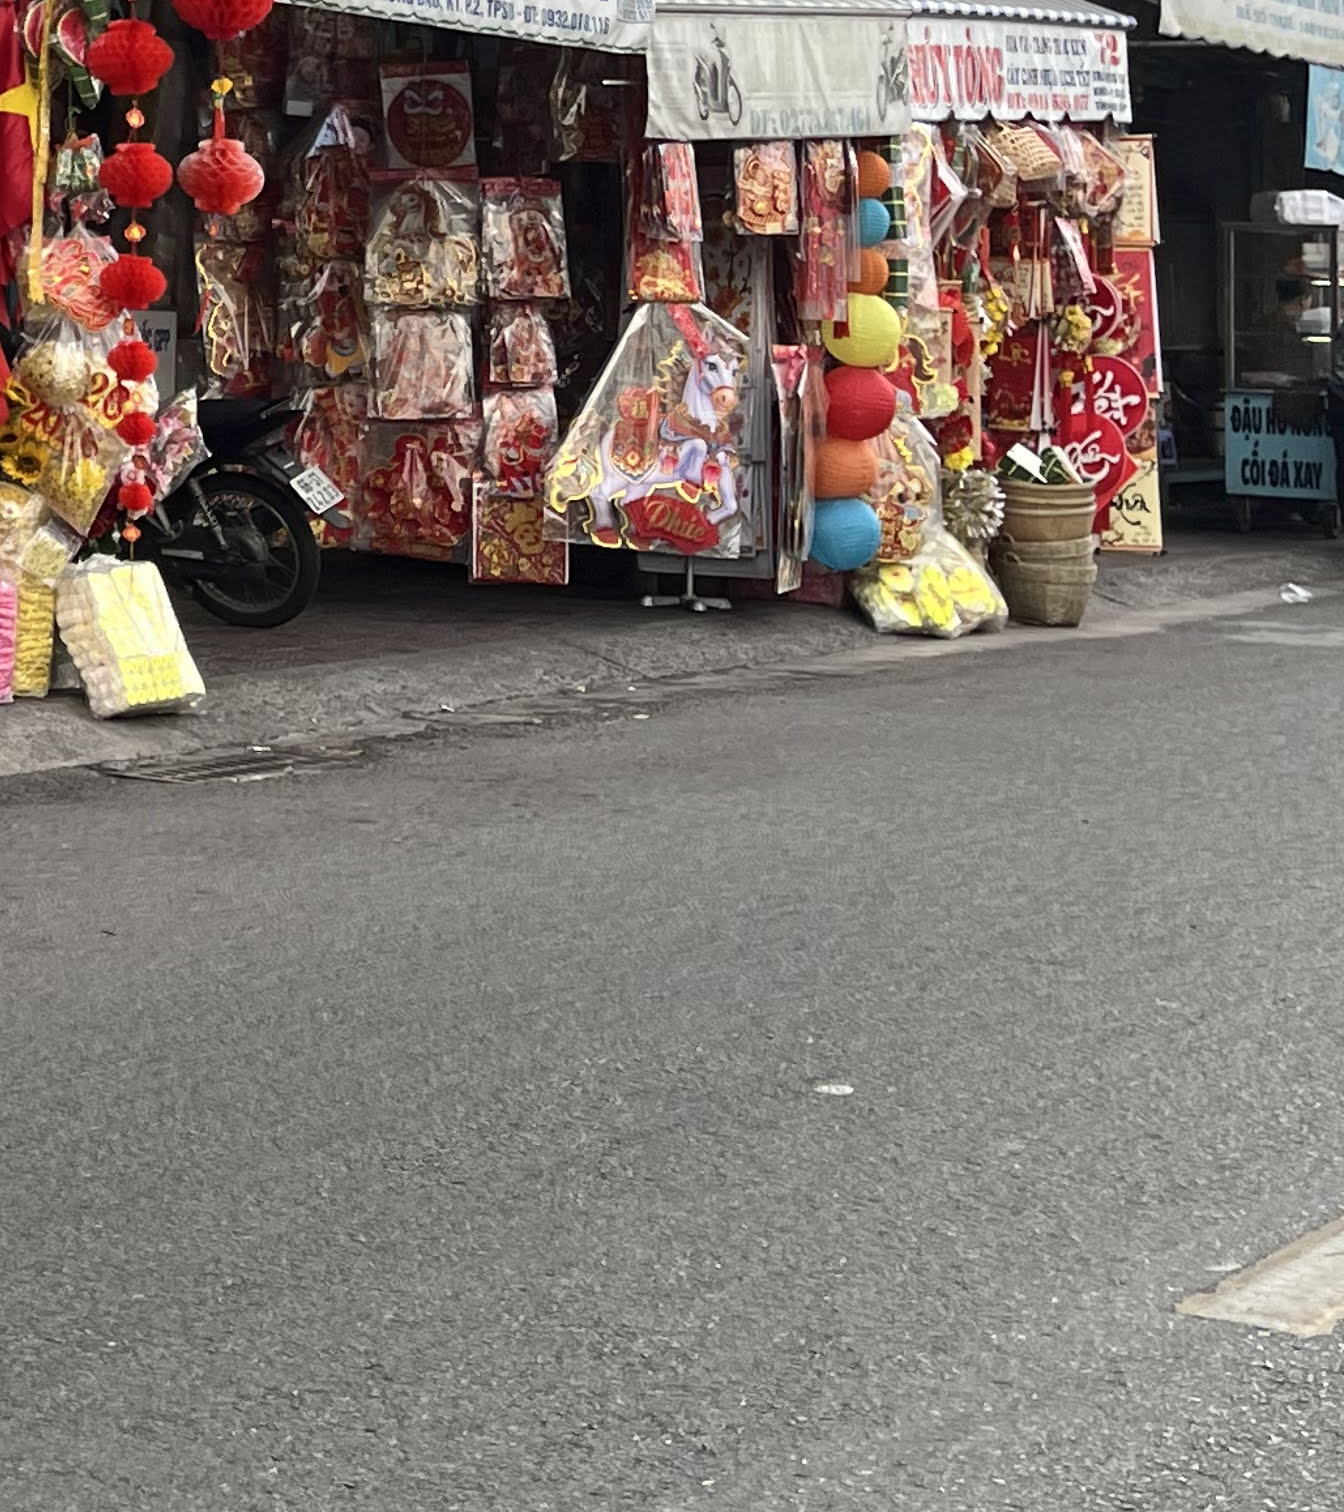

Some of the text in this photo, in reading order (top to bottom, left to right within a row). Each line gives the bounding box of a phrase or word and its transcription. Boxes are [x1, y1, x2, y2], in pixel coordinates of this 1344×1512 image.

[1230, 397, 1262, 441] ĐẬU
[1241, 440, 1323, 489] CỐI ĐÁ XAY
